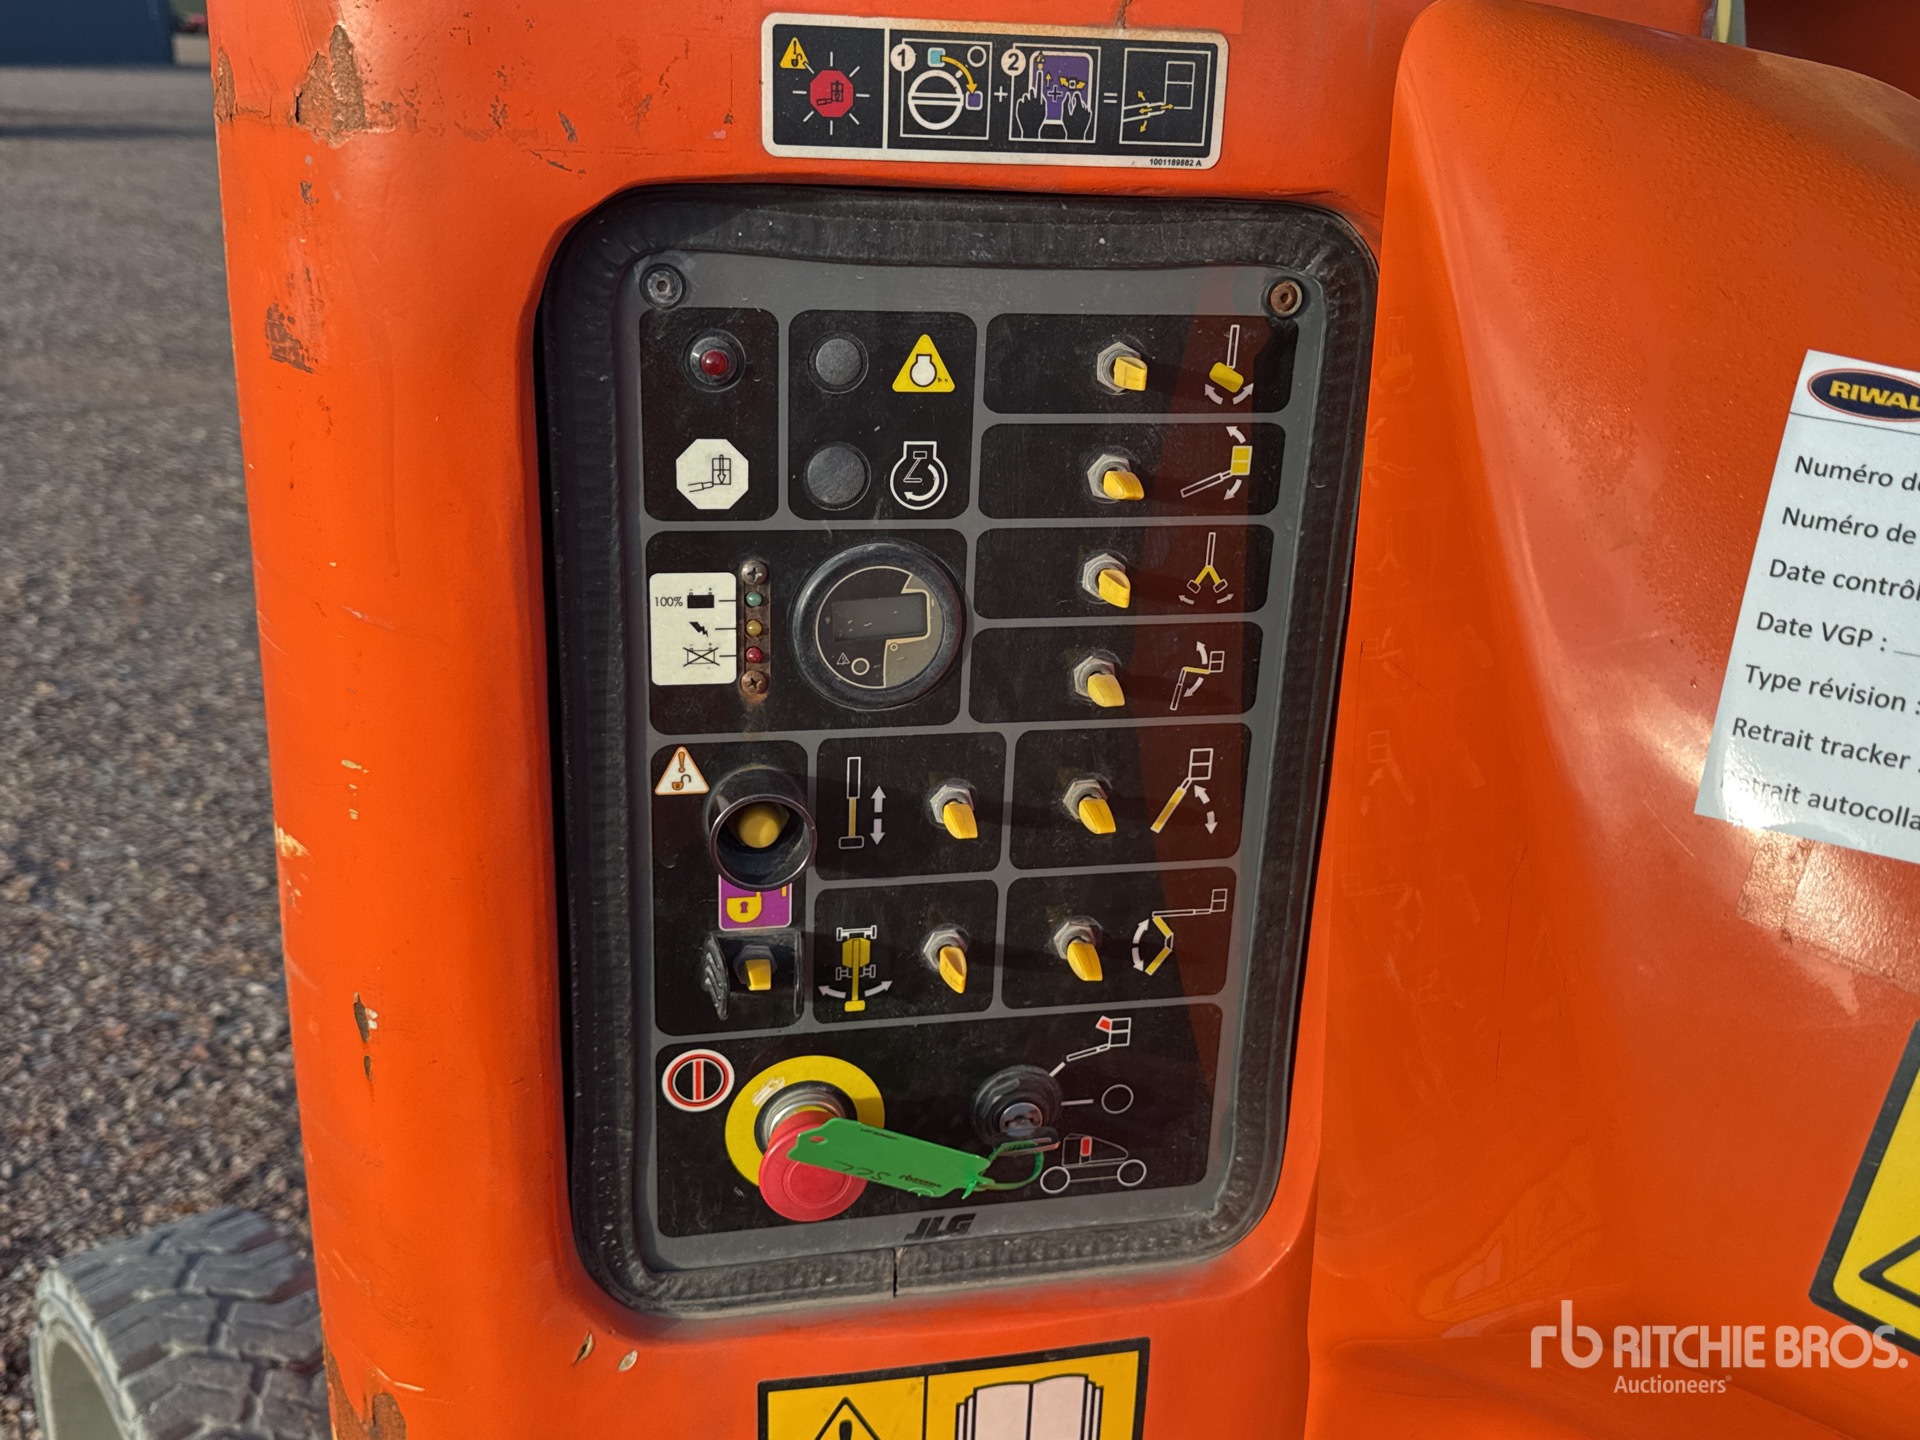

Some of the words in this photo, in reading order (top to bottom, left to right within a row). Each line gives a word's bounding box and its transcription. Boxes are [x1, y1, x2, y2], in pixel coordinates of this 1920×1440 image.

[896, 48, 906, 67] 1
[1007, 52, 1020, 71] 2
[1829, 379, 1920, 412] RIWAL
[1795, 455, 1893, 487] Numéro
[1901, 472, 1920, 491] d
[1782, 506, 1879, 539] Numéro
[1886, 523, 1917, 545] de
[1769, 558, 1825, 585] Date
[655, 596, 684, 608] 100%
[1756, 611, 1813, 638] Date
[1822, 621, 1873, 647] VGP
[1745, 663, 1801, 692] Type
[1808, 677, 1907, 712] révision
[1732, 717, 1814, 751] Retrait
[1821, 736, 1911, 769] tracker
[1807, 792, 1920, 831] autocolla
[904, 1213, 977, 1241] JLG
